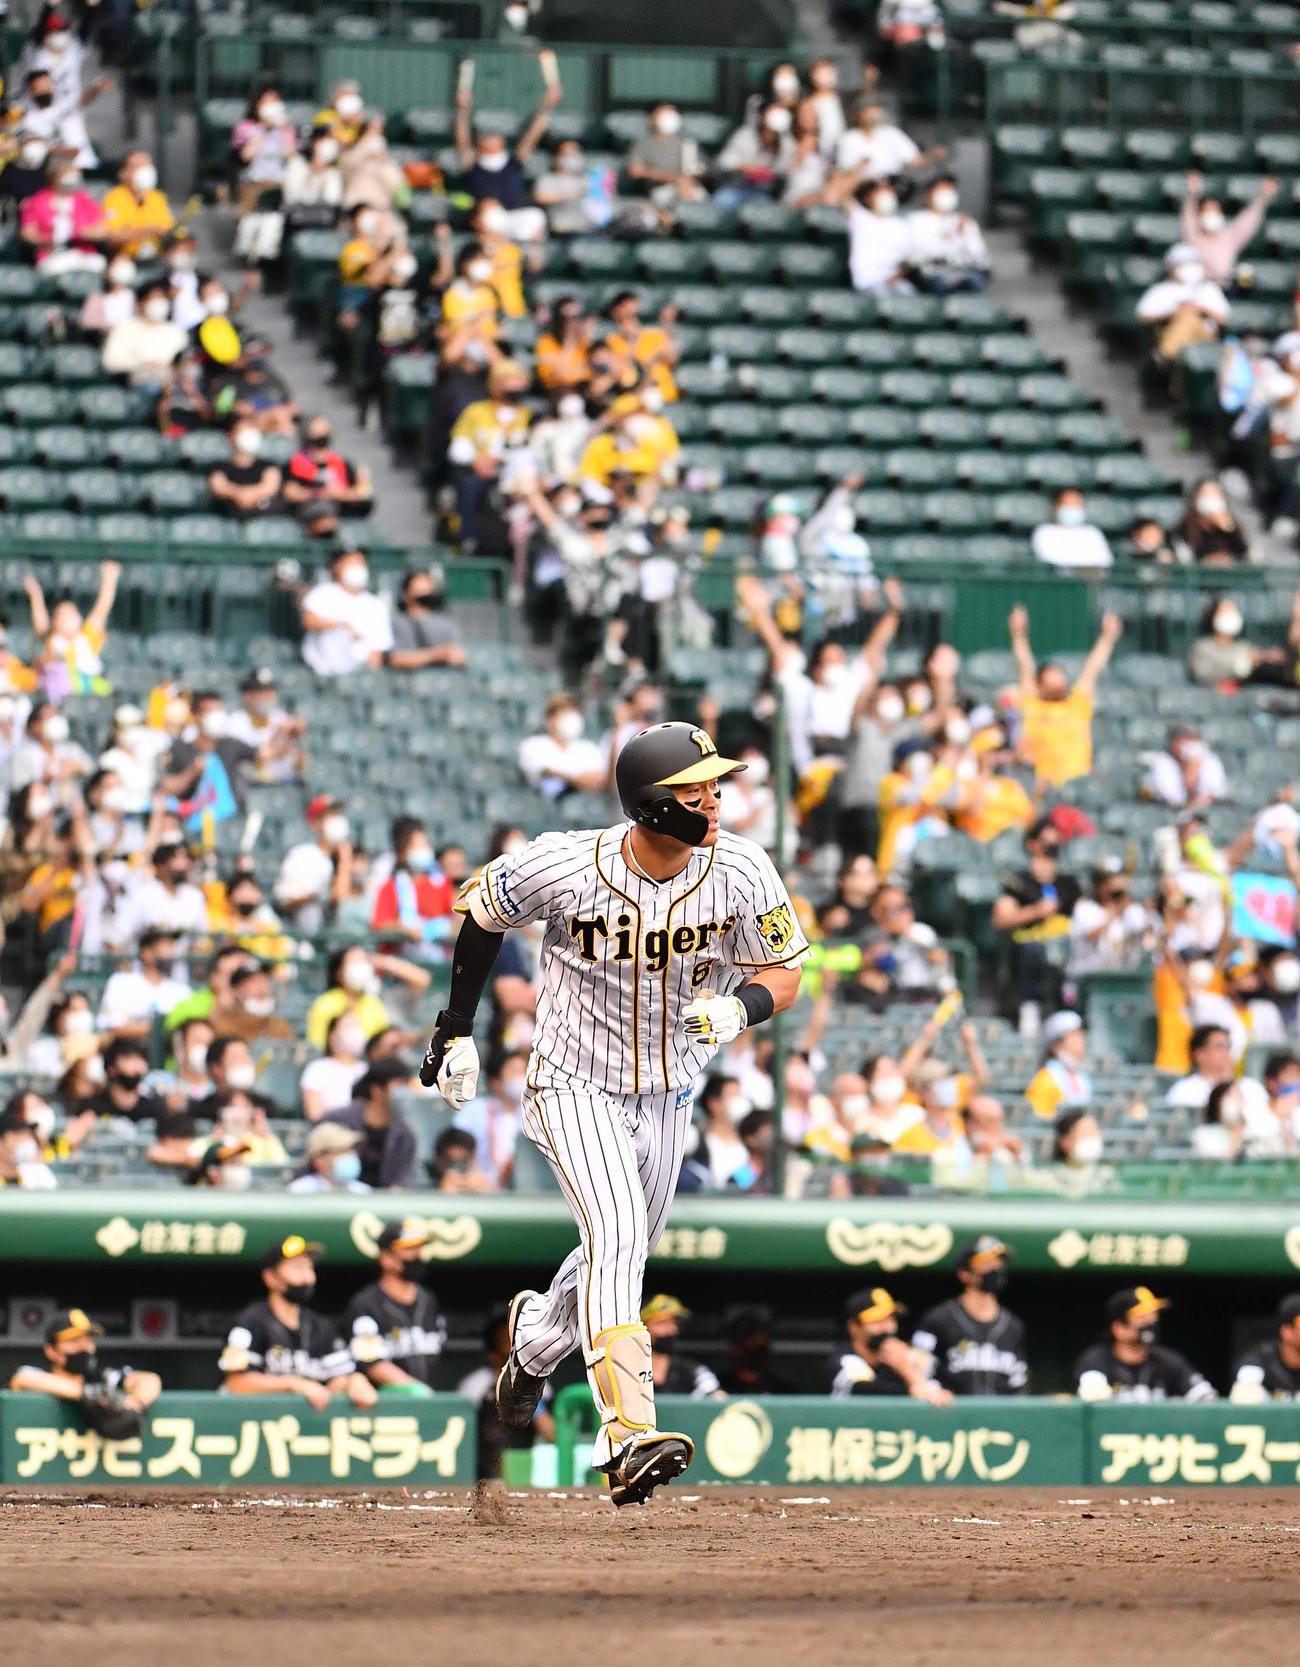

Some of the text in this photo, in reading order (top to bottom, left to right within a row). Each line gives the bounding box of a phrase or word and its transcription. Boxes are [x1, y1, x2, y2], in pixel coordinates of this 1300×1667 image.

[569, 914, 737, 972] Tigers
[785, 1426, 1031, 1483] 損保ジャパン
[1099, 1424, 1300, 1484] アサヒスー
